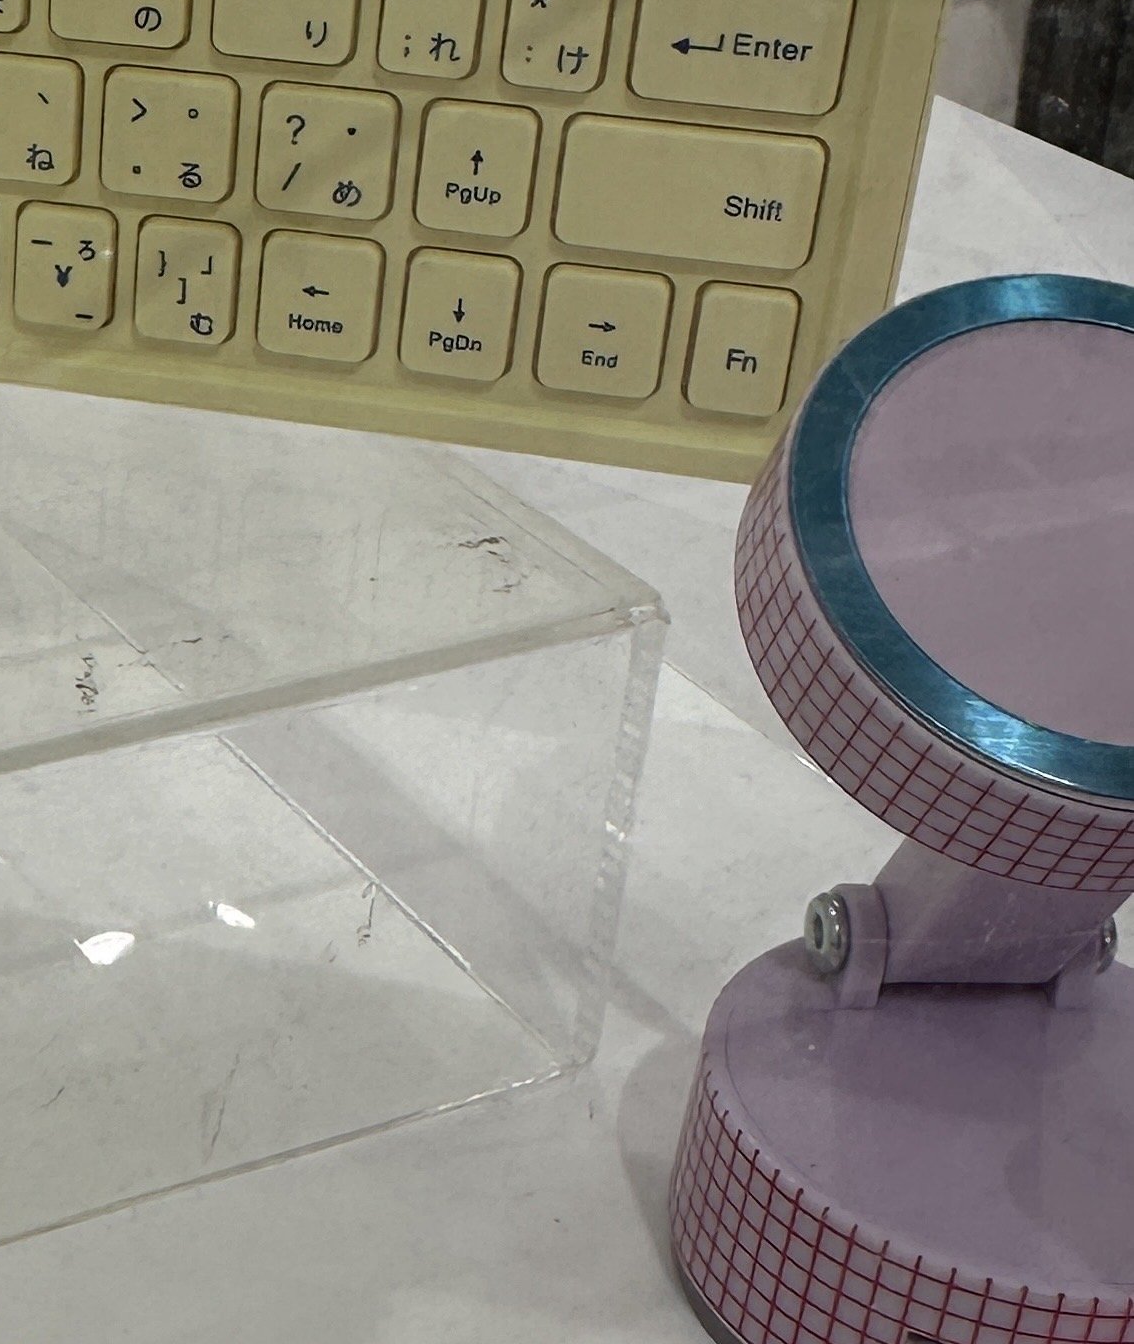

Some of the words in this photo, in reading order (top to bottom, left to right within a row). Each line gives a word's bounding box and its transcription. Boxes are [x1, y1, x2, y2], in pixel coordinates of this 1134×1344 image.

[134, 6, 163, 33] の
[305, 20, 328, 49] り
[428, 32, 461, 62] れ
[732, 32, 814, 62] Enter
[556, 44, 590, 75] け
[285, 114, 306, 146] ?
[25, 143, 55, 171] ね
[177, 162, 203, 189] る
[332, 180, 363, 208] め
[445, 182, 502, 206] PgUp
[723, 194, 783, 222] Shift
[189, 312, 214, 336] む
[288, 313, 344, 335] Home
[428, 330, 483, 353] PgDn
[581, 349, 619, 369] End
[725, 348, 758, 374] Fn
